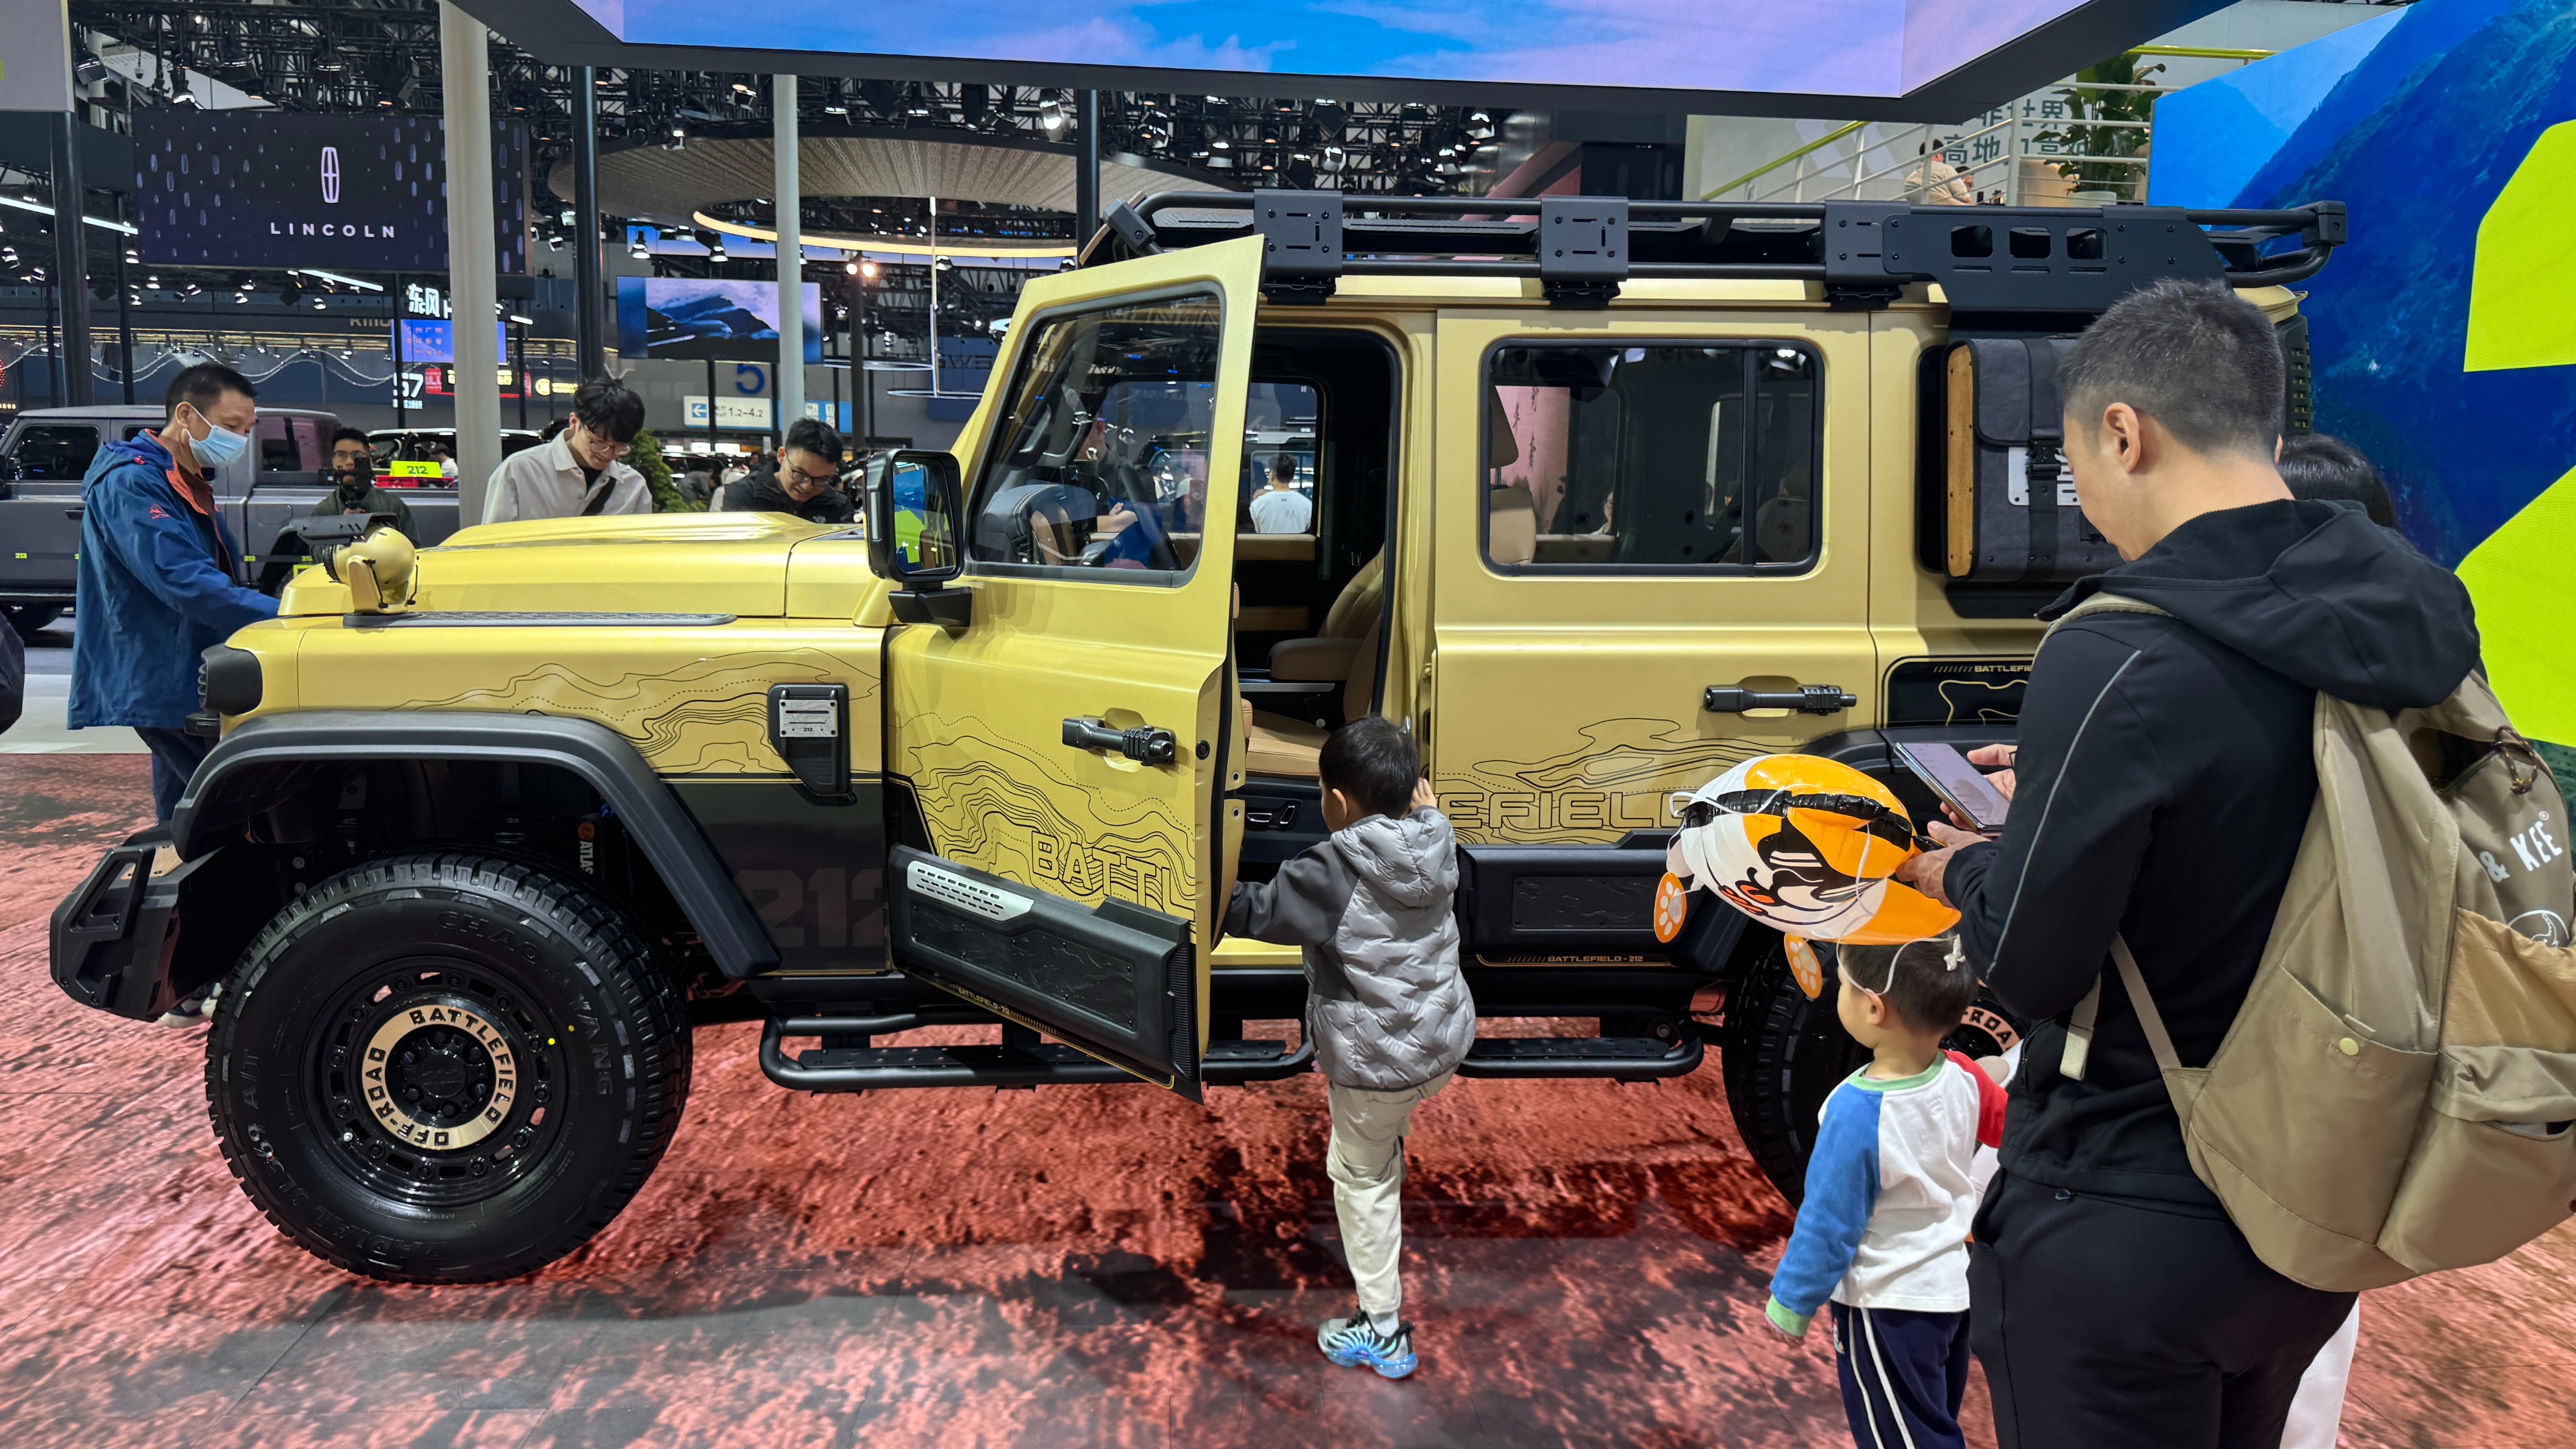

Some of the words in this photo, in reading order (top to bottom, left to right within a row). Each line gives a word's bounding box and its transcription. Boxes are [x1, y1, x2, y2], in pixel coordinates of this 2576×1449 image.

[270, 222, 395, 238] LINCOLN
[408, 283, 440, 317] 东风
[407, 465, 428, 474] 212
[2479, 850, 2510, 883] &
[409, 1007, 514, 1124] BATTLEFIELD
[365, 1047, 449, 1147] OFF-ROAD
